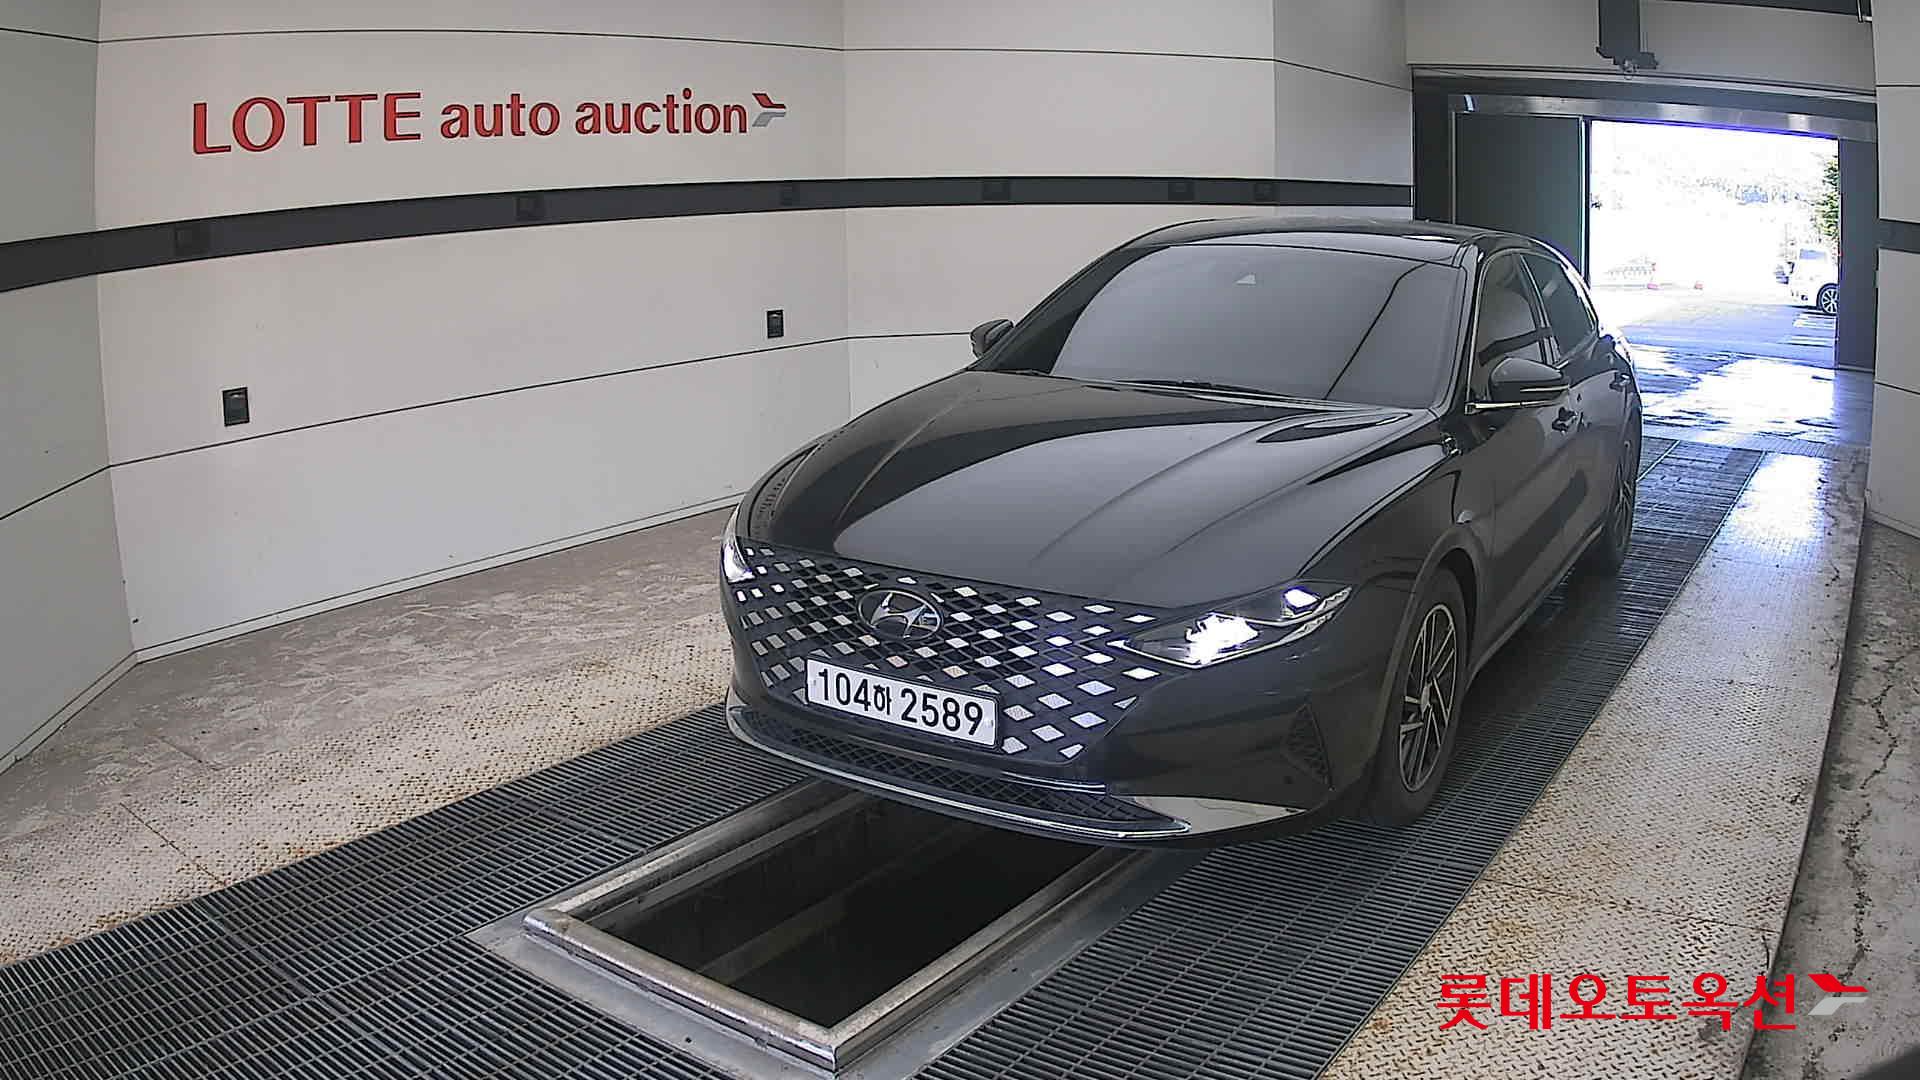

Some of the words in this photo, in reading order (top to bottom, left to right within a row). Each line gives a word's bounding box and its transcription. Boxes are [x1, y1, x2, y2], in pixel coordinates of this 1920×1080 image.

[192, 91, 422, 155] LOTTE
[439, 92, 561, 139] auto
[574, 87, 748, 136] auction
[818, 668, 892, 716] 104하
[900, 687, 984, 736] 2589
